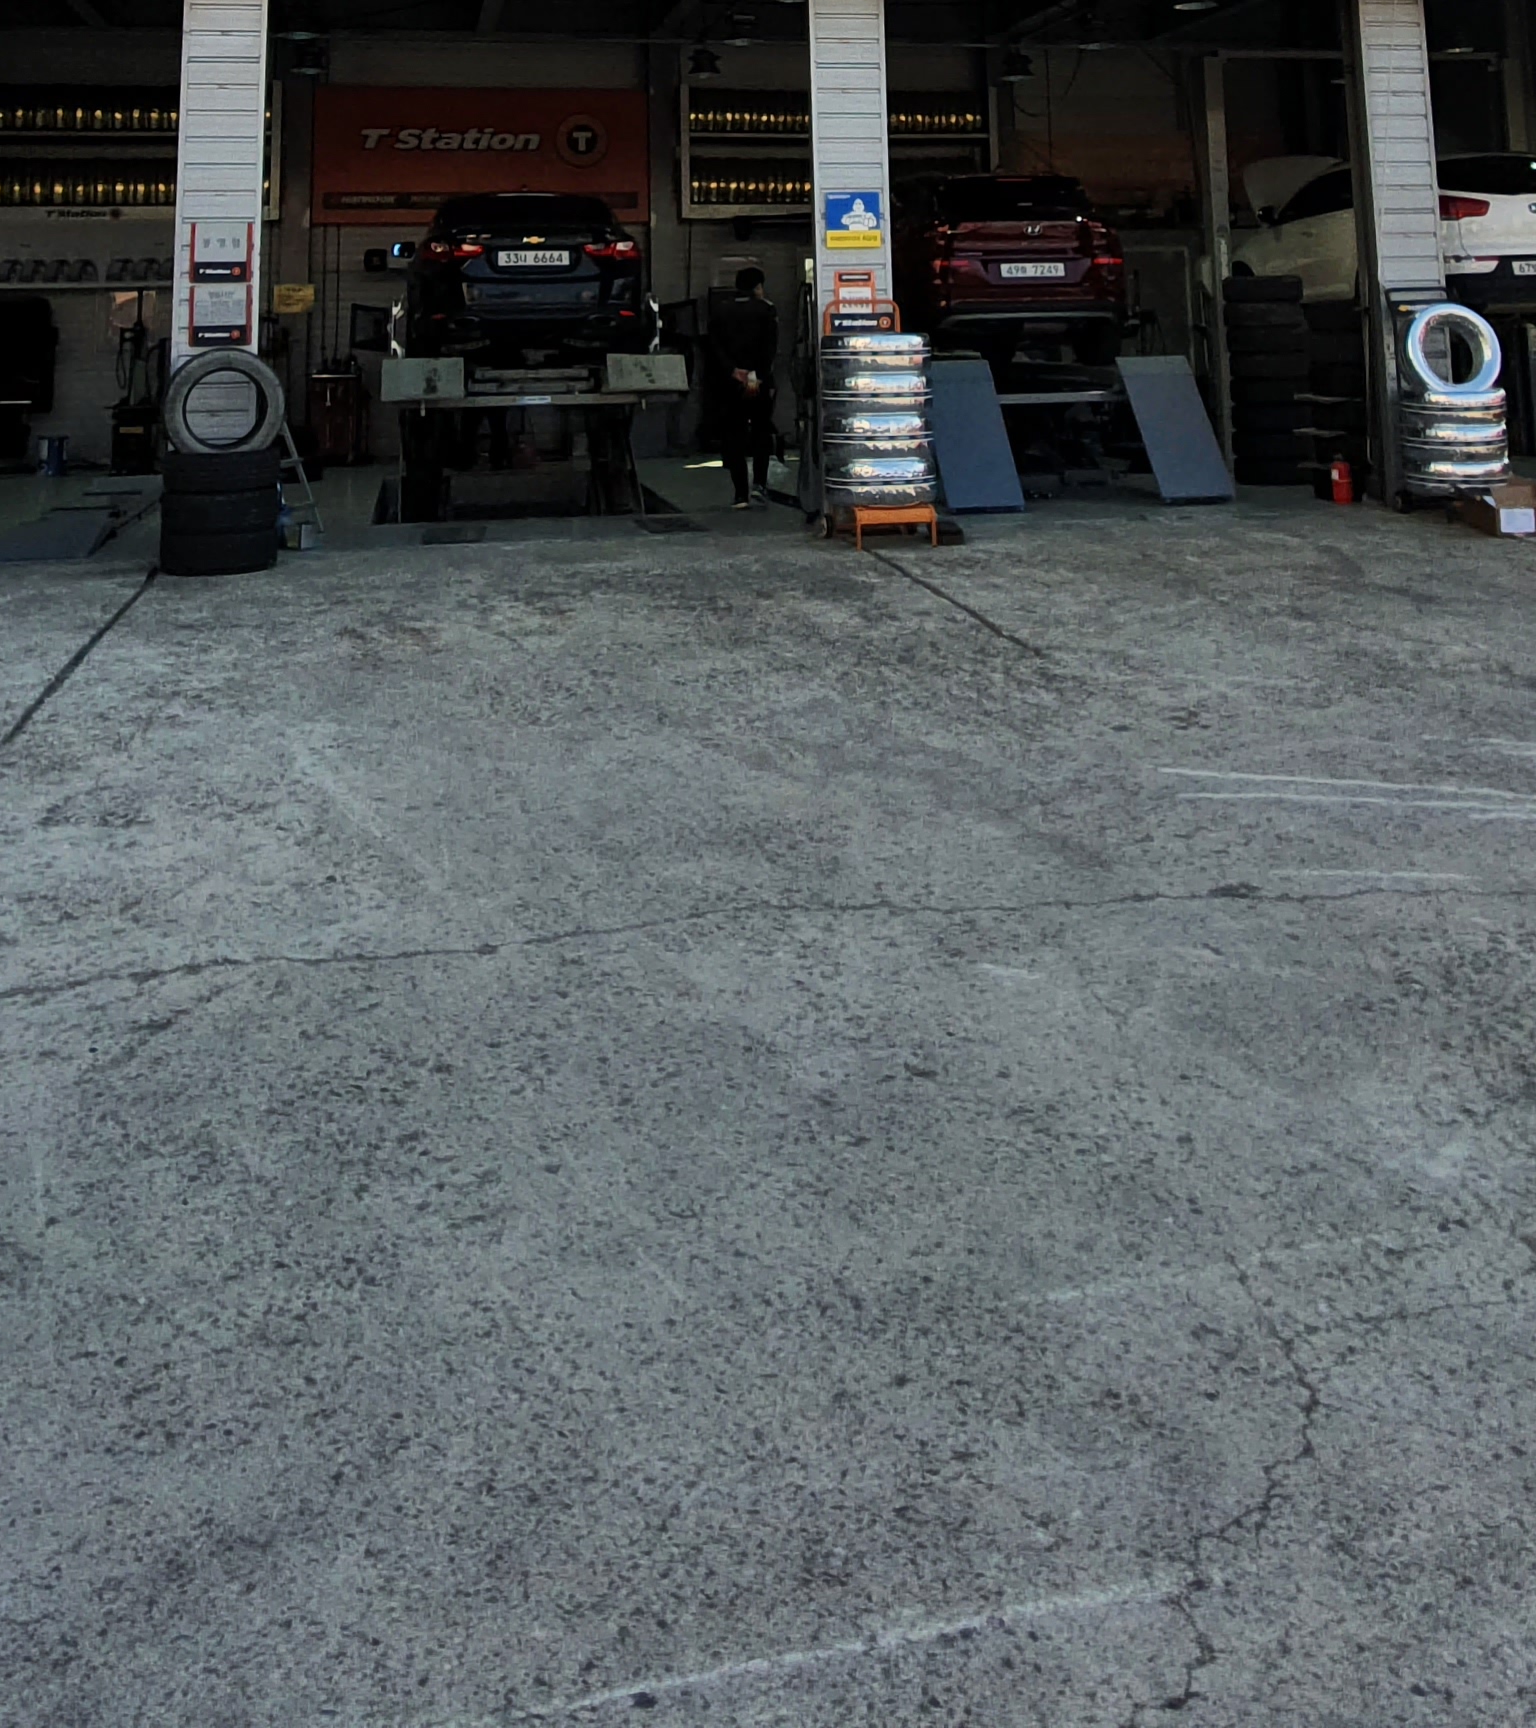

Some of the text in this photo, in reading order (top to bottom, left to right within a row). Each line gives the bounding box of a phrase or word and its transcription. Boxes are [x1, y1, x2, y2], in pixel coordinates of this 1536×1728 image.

[361, 128, 390, 150] T
[391, 127, 540, 152] Station
[533, 252, 563, 264] 6664
